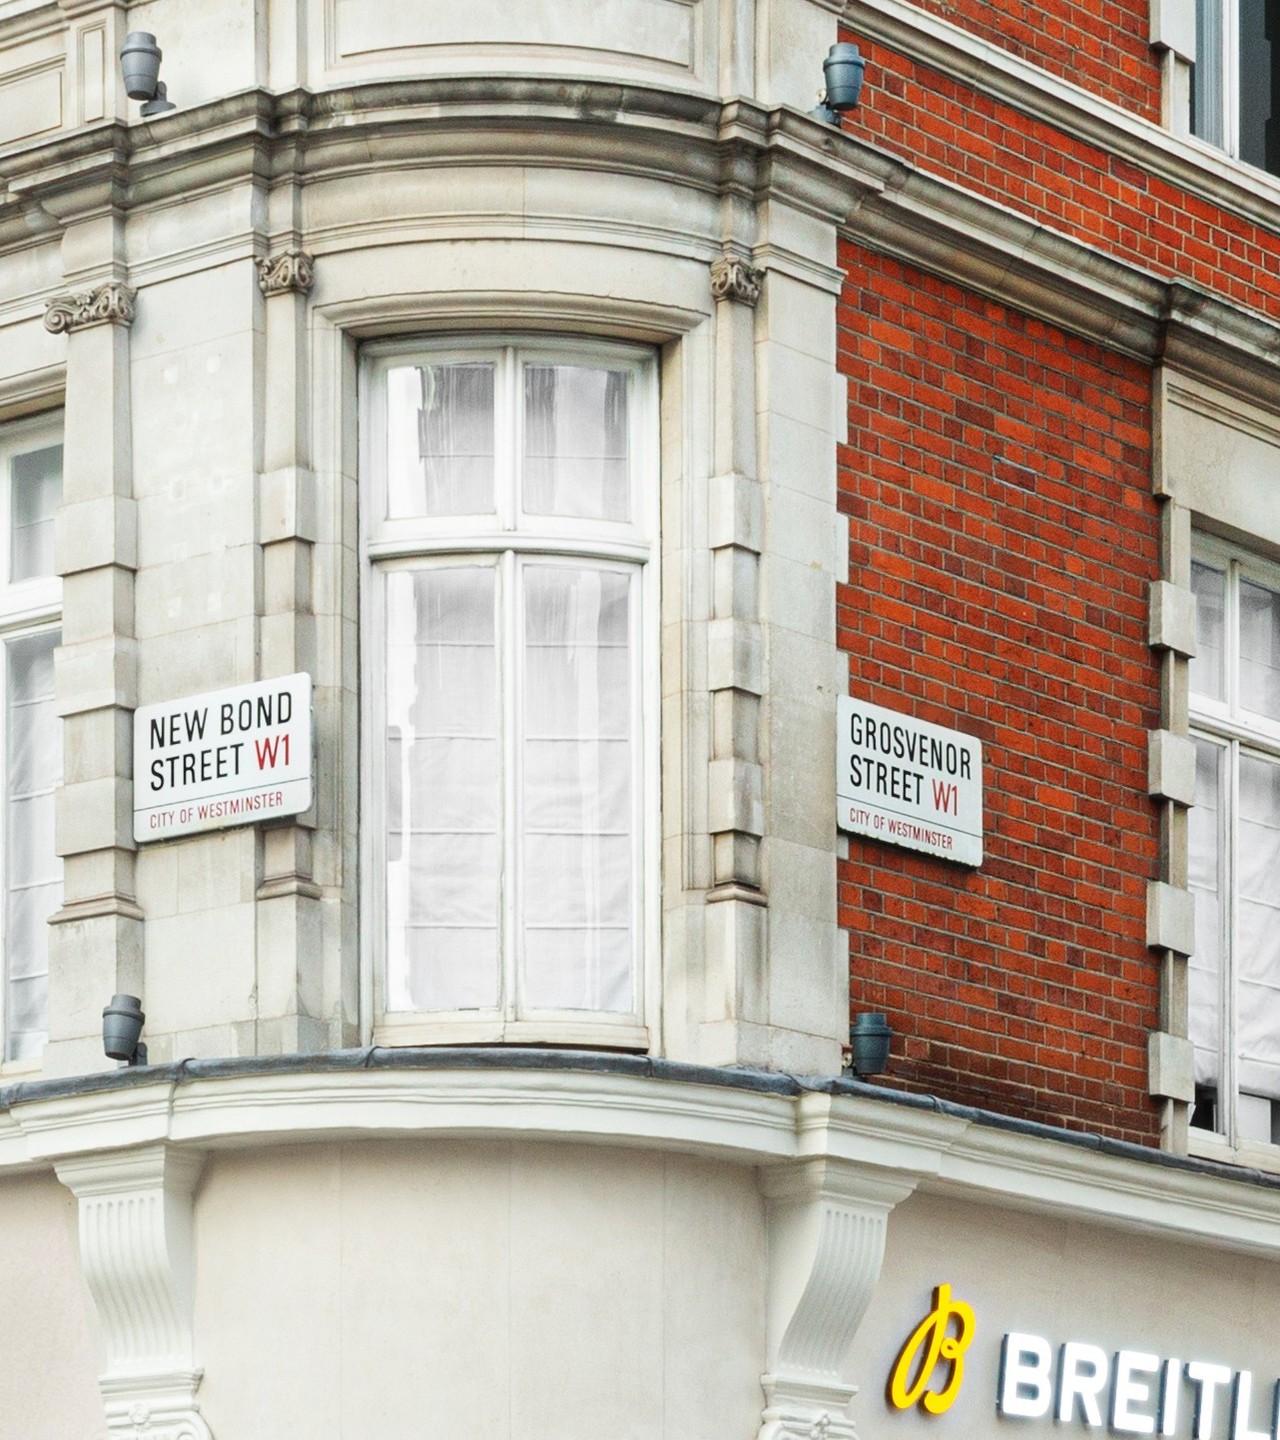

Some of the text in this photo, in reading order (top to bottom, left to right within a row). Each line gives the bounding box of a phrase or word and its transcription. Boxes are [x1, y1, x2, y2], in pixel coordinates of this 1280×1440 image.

[150, 691, 292, 750] NEW BOND
[850, 712, 972, 780] GROSVENOR
[150, 734, 290, 791] STREET W1
[850, 754, 958, 816] STREET W1
[149, 791, 283, 829] CITY OF WESTMINSTER
[849, 807, 953, 850] CITY OF WESTMINSTER
